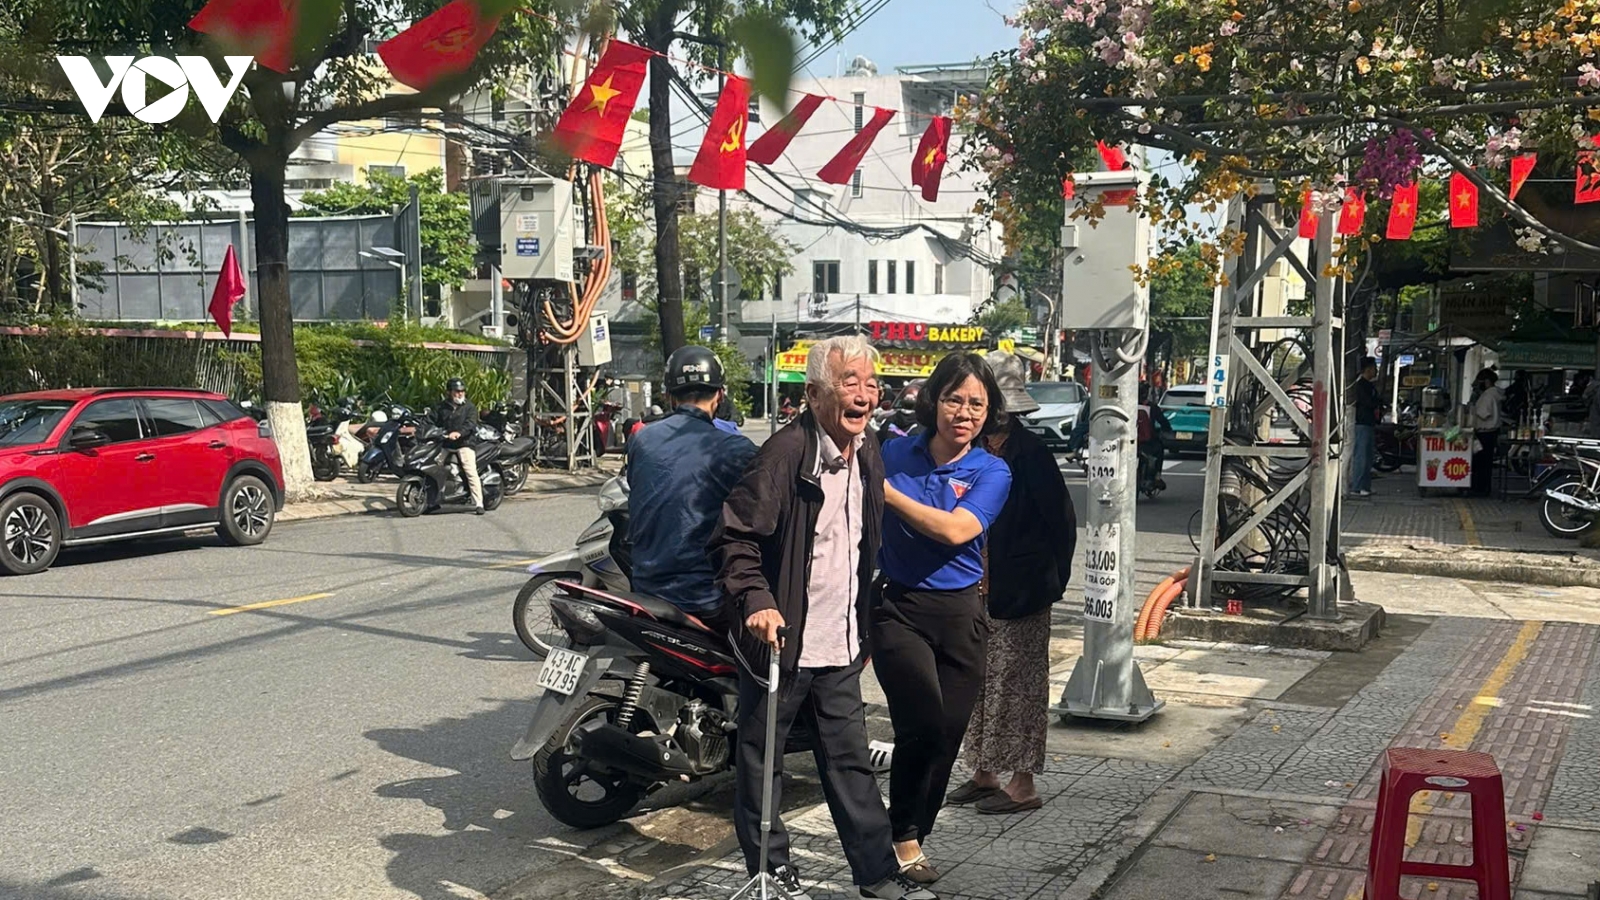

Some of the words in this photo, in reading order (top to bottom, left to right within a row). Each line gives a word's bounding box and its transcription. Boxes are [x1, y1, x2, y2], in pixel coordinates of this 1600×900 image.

[869, 321, 926, 341] THU
[928, 326, 984, 343] BAKERY
[783, 353, 807, 365] TH
[1447, 463, 1467, 476] 10K
[1099, 576, 1116, 586] GÓP
[551, 650, 581, 673] 43-AC
[540, 667, 577, 692] 047.95
